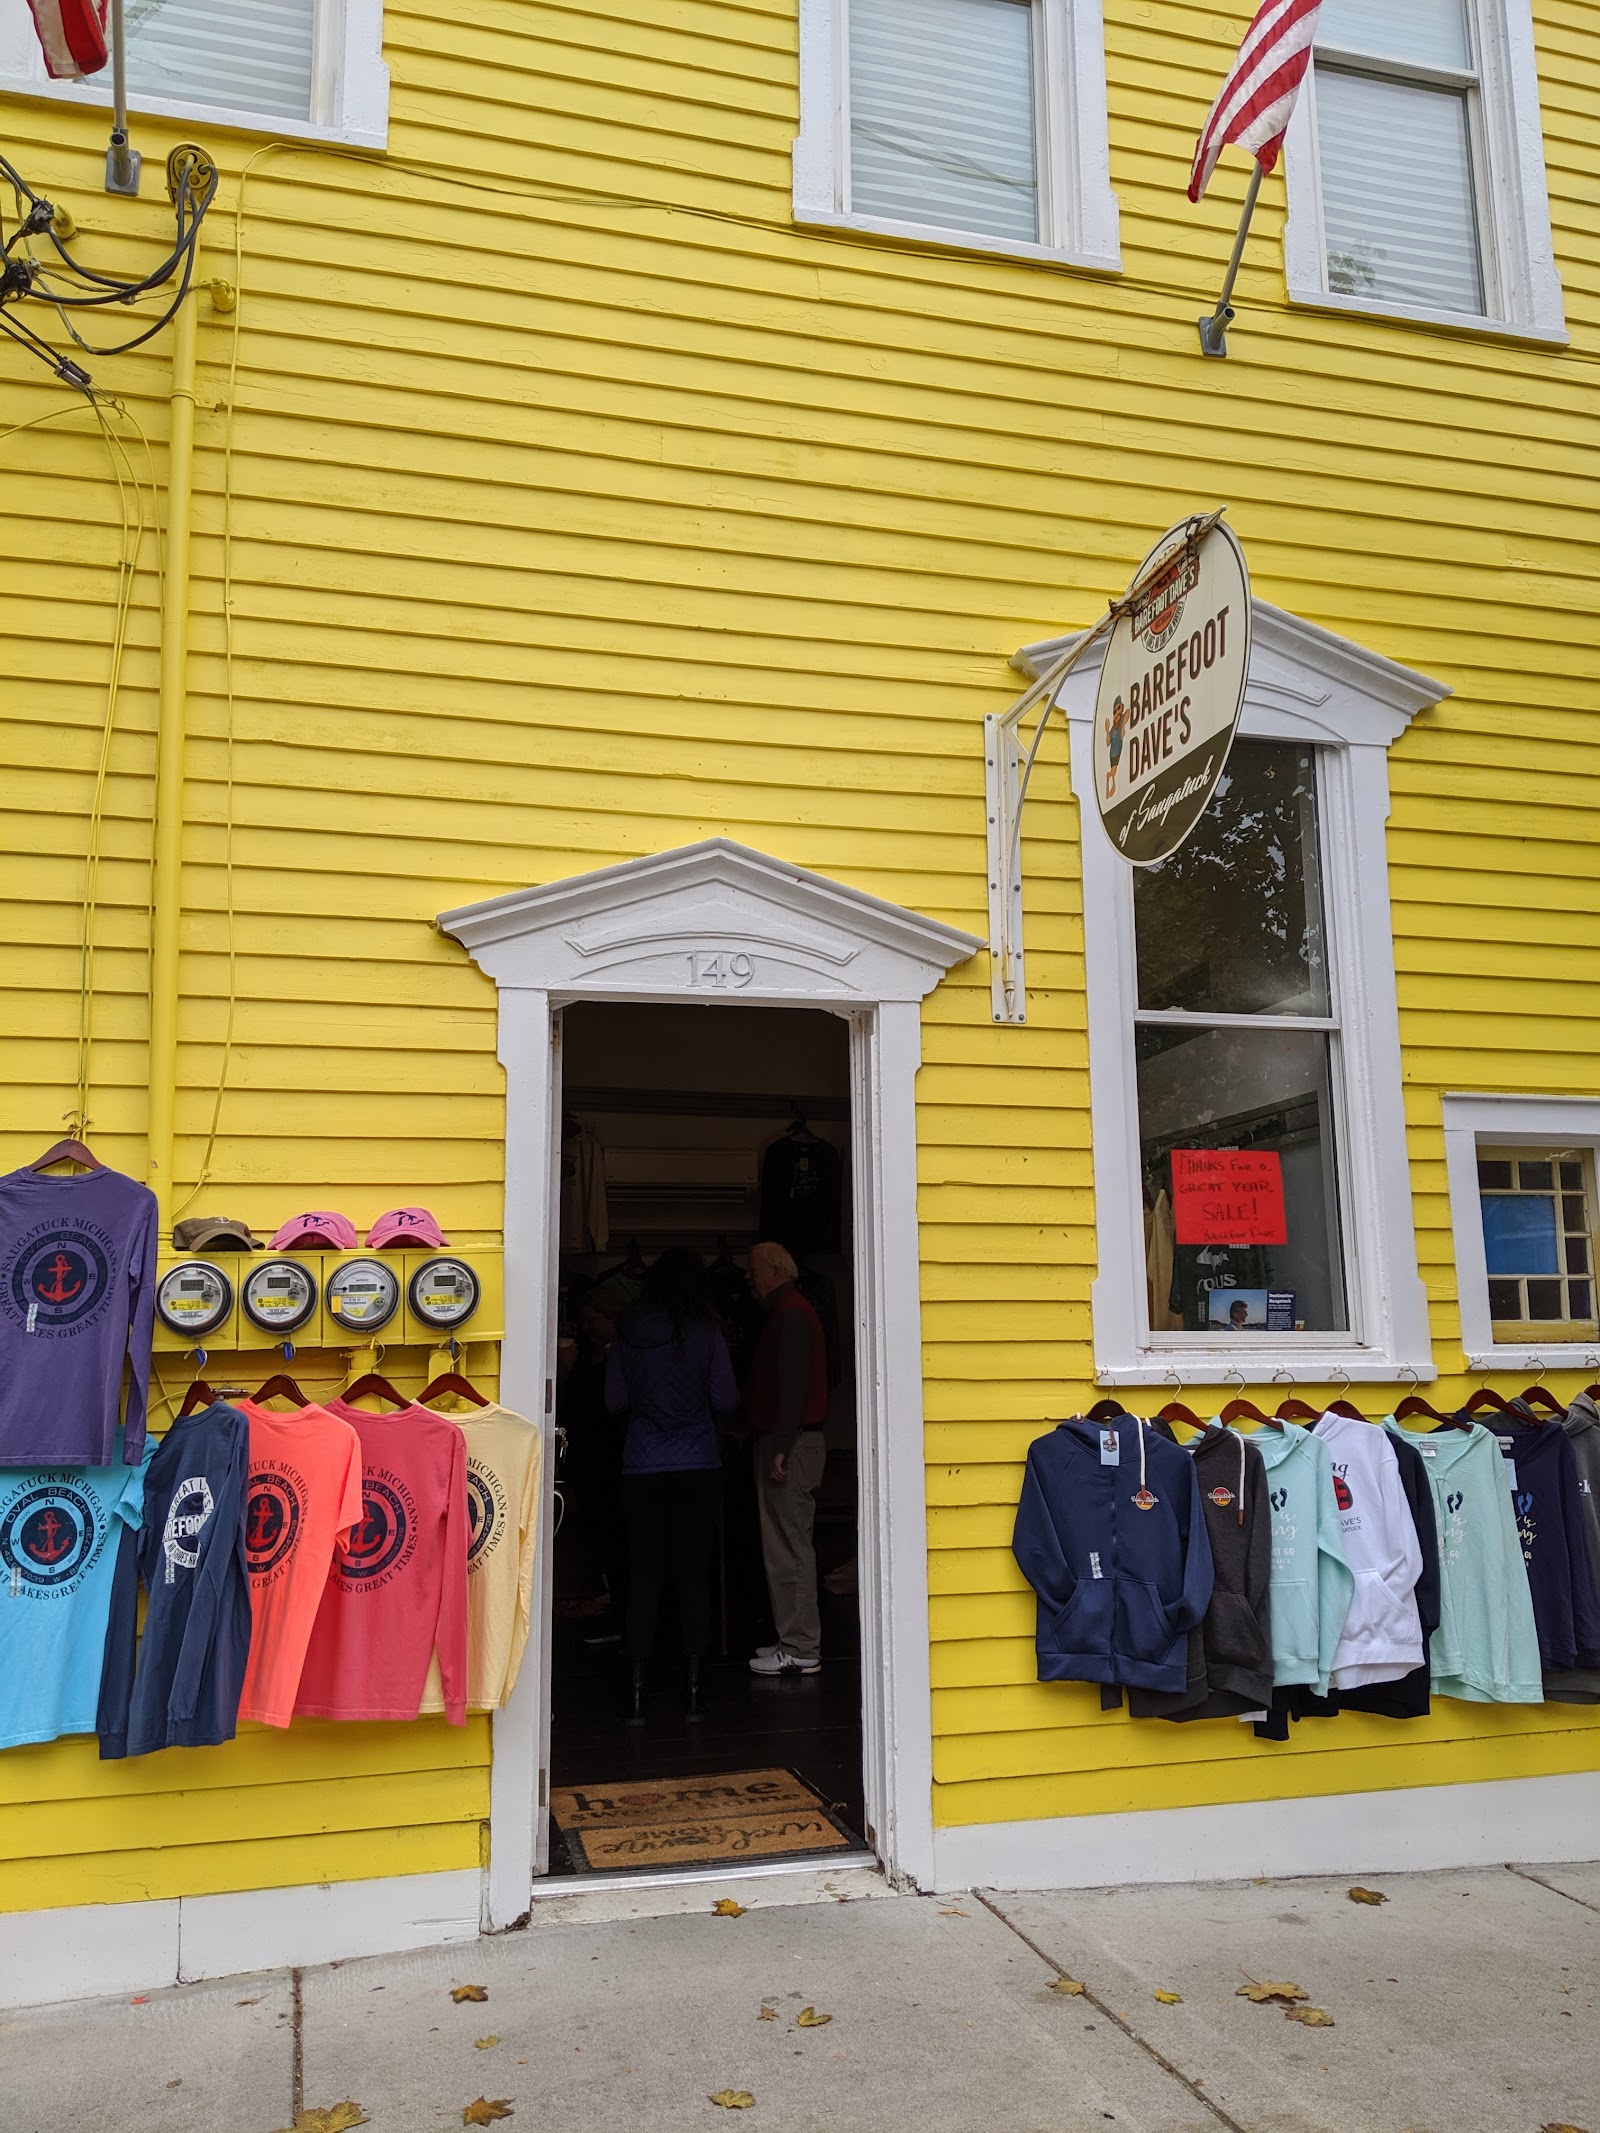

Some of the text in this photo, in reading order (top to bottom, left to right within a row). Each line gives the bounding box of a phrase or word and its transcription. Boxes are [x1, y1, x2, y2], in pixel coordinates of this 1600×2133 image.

[1169, 564, 1195, 603] DAVE'S
[1130, 605, 1230, 730] BAREFOOT
[1129, 695, 1192, 784] DAVE'S
[1119, 754, 1214, 848] of Saugatuck
[686, 950, 755, 988] 149
[1180, 1153, 1225, 1175] THANKS
[1180, 1180, 1274, 1194] GREAT YEAR
[1202, 1197, 1259, 1221] SALE!
[2, 1218, 118, 1271] SAUGATUCK MICHIGAN
[20, 1231, 100, 1263] OVAL BEACH
[58, 1312, 99, 1339] GREAT
[99, 1275, 117, 1313] TIMES
[0, 1473, 107, 1523] UGATUCK MICHIGAN
[263, 1485, 271, 1493] N
[267, 1475, 297, 1507] BEACH
[278, 1461, 309, 1516] MICHIGAN
[366, 1481, 402, 1515] BEACH
[378, 1468, 419, 1525] MICHIGAN
[466, 1457, 507, 1511] MICHIGAN
[6, 1487, 88, 1523] OVAL BEACH
[1280, 1511, 1297, 1522] is
[1523, 1515, 1537, 1528] is
[11, 1538, 20, 1546] W
[79, 1529, 84, 1537] E
[388, 1529, 396, 1537] E
[481, 1521, 506, 1559] TIMES
[20, 1532, 108, 1600] AKES GREAT TIMES
[355, 1570, 394, 1594] GREAT
[394, 1534, 418, 1573] TIMES
[1283, 1547, 1295, 1556] GO
[49, 1566, 56, 1574] S
[252, 1567, 285, 1588] GREAT
